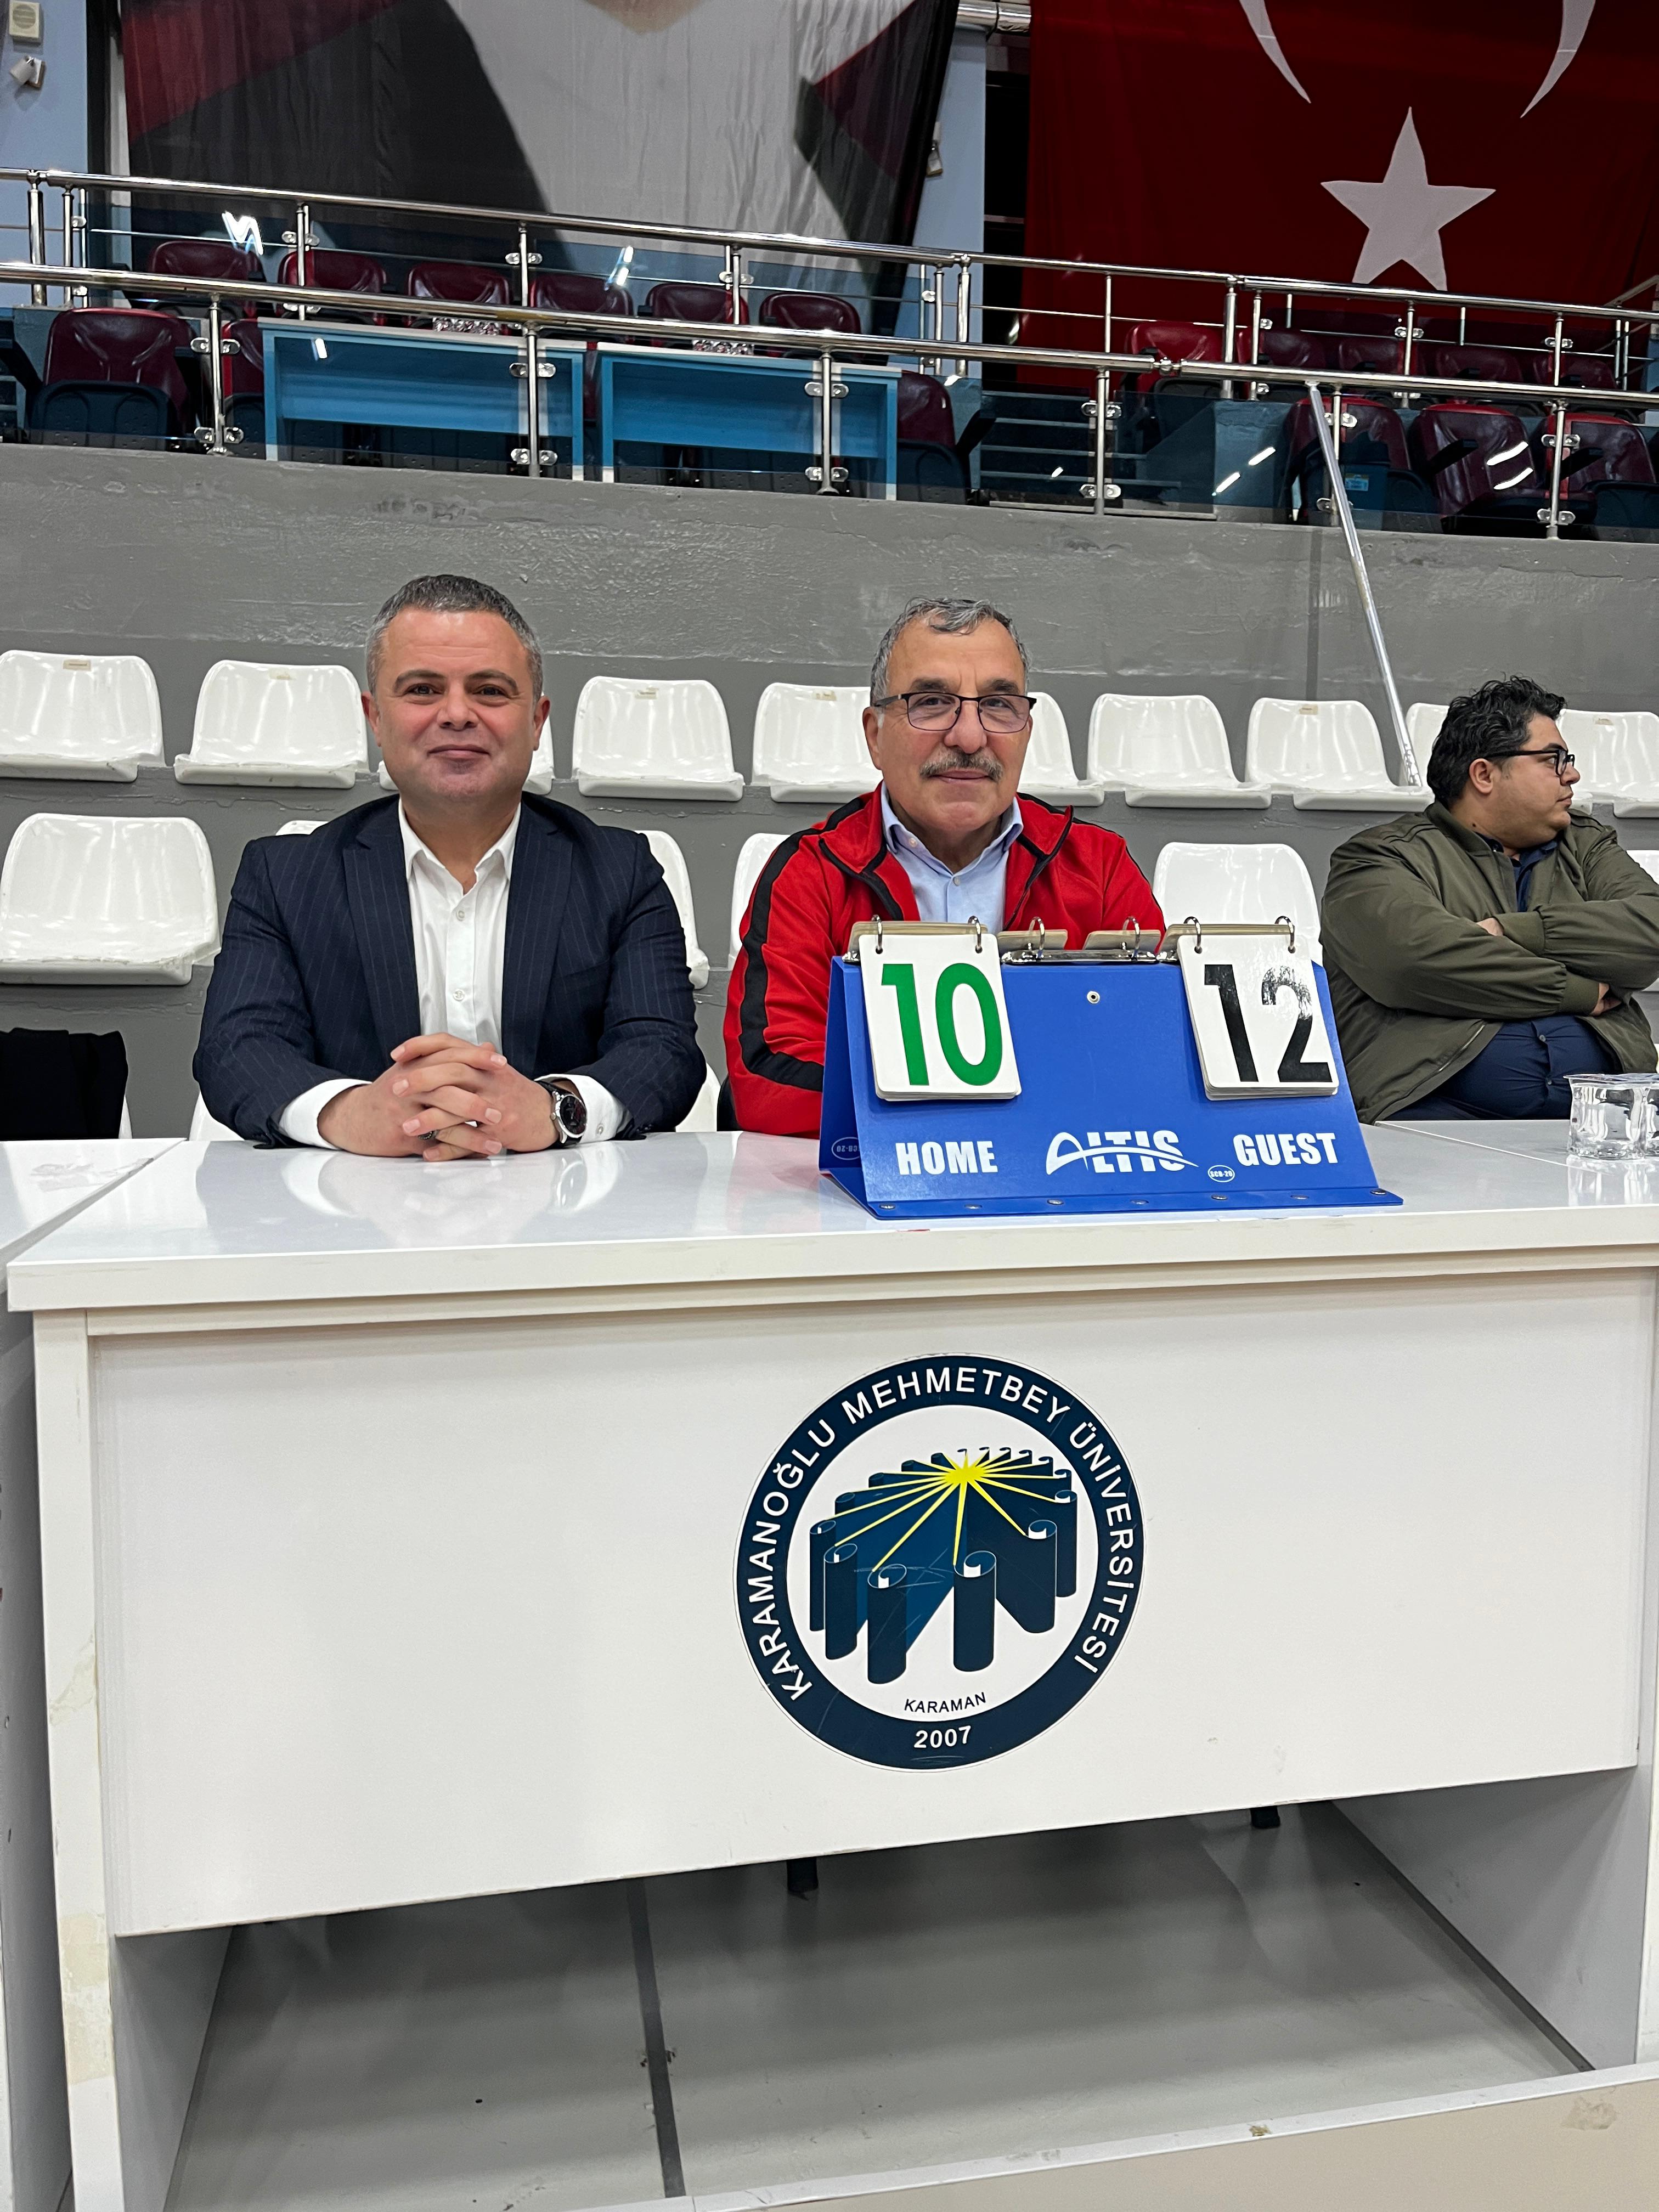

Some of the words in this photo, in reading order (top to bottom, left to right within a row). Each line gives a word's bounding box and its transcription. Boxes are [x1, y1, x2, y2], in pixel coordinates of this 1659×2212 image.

[881, 963, 1002, 1086] 10
[1204, 963, 1333, 1082] 12
[895, 1141, 999, 1175] HOME
[1046, 1130, 1199, 1175] ALTIS
[1233, 1132, 1339, 1167] GUEST
[748, 1419, 836, 1700] KARAMANOĞLU
[842, 1367, 1070, 1424] MEHMETBEY
[904, 1692, 987, 1713] KARAMAN
[913, 1725, 972, 1749] 2007
